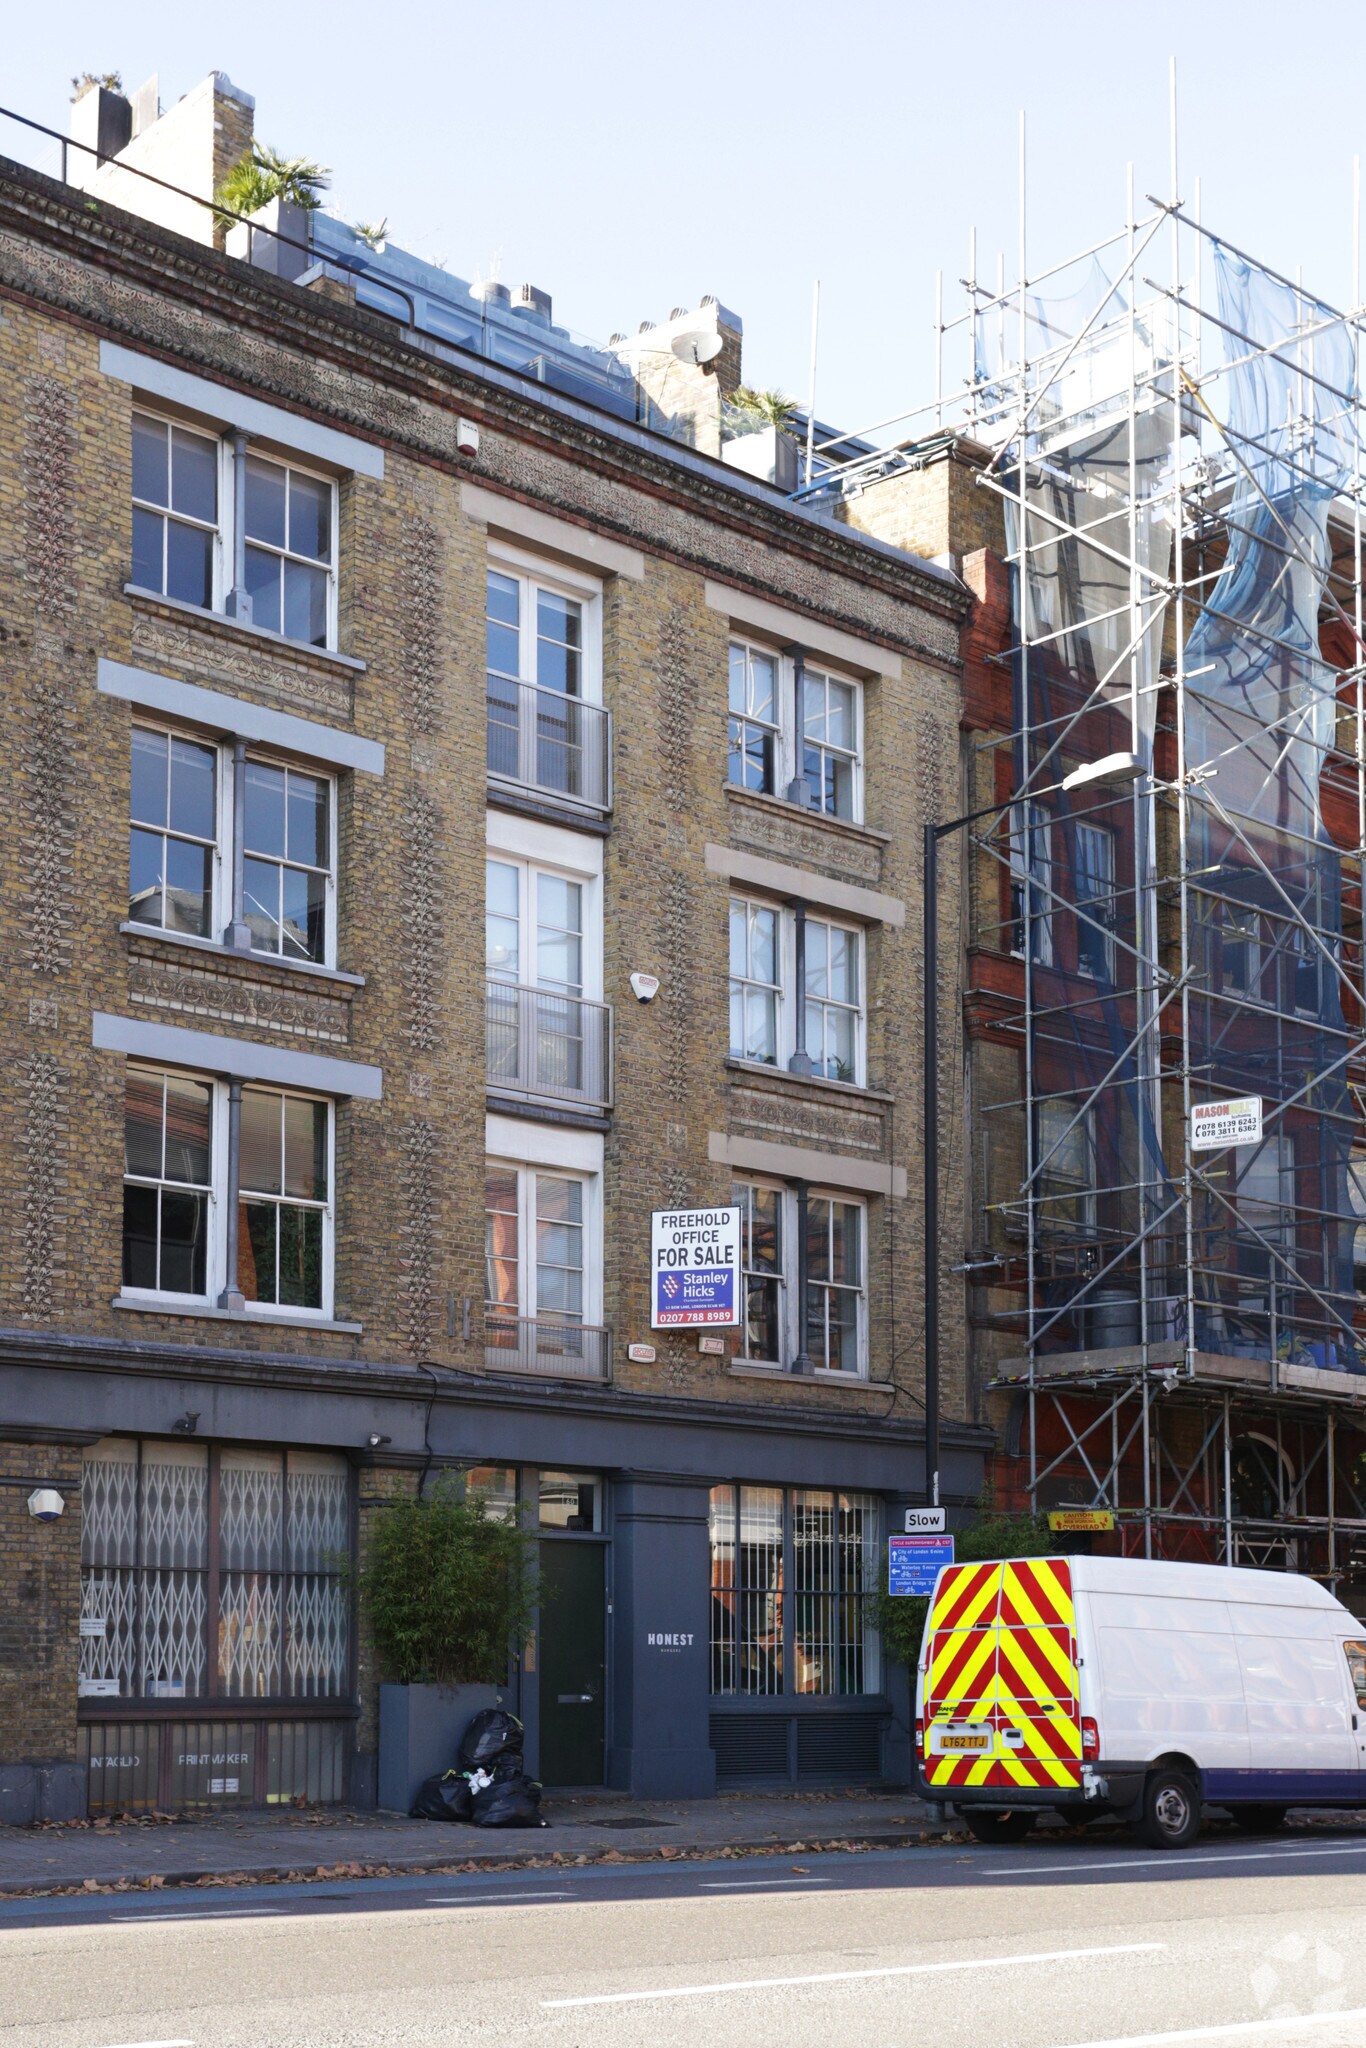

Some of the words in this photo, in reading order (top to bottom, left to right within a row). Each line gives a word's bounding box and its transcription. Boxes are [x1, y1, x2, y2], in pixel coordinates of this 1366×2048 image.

[1218, 1120, 1236, 1128] 6139
[1238, 1117, 1257, 1125] 6243
[1218, 1127, 1236, 1135] 3811
[1238, 1124, 1257, 1132] 6362
[661, 1212, 730, 1229] FREEHOLD
[672, 1230, 719, 1245] OFFICE
[657, 1247, 688, 1267] FOR
[694, 1245, 734, 1266] SALE
[683, 1272, 728, 1286] Stanley
[683, 1286, 715, 1298] Hicks
[660, 1313, 684, 1322] 0207
[687, 1312, 704, 1321] 788
[707, 1311, 731, 1321] 8989
[908, 1514, 940, 1526] Slow
[648, 1633, 694, 1645] HONEST
[943, 1737, 966, 1747] LT62
[968, 1737, 985, 1747] TTJ
[178, 1753, 249, 1766] PRINTMAKER
